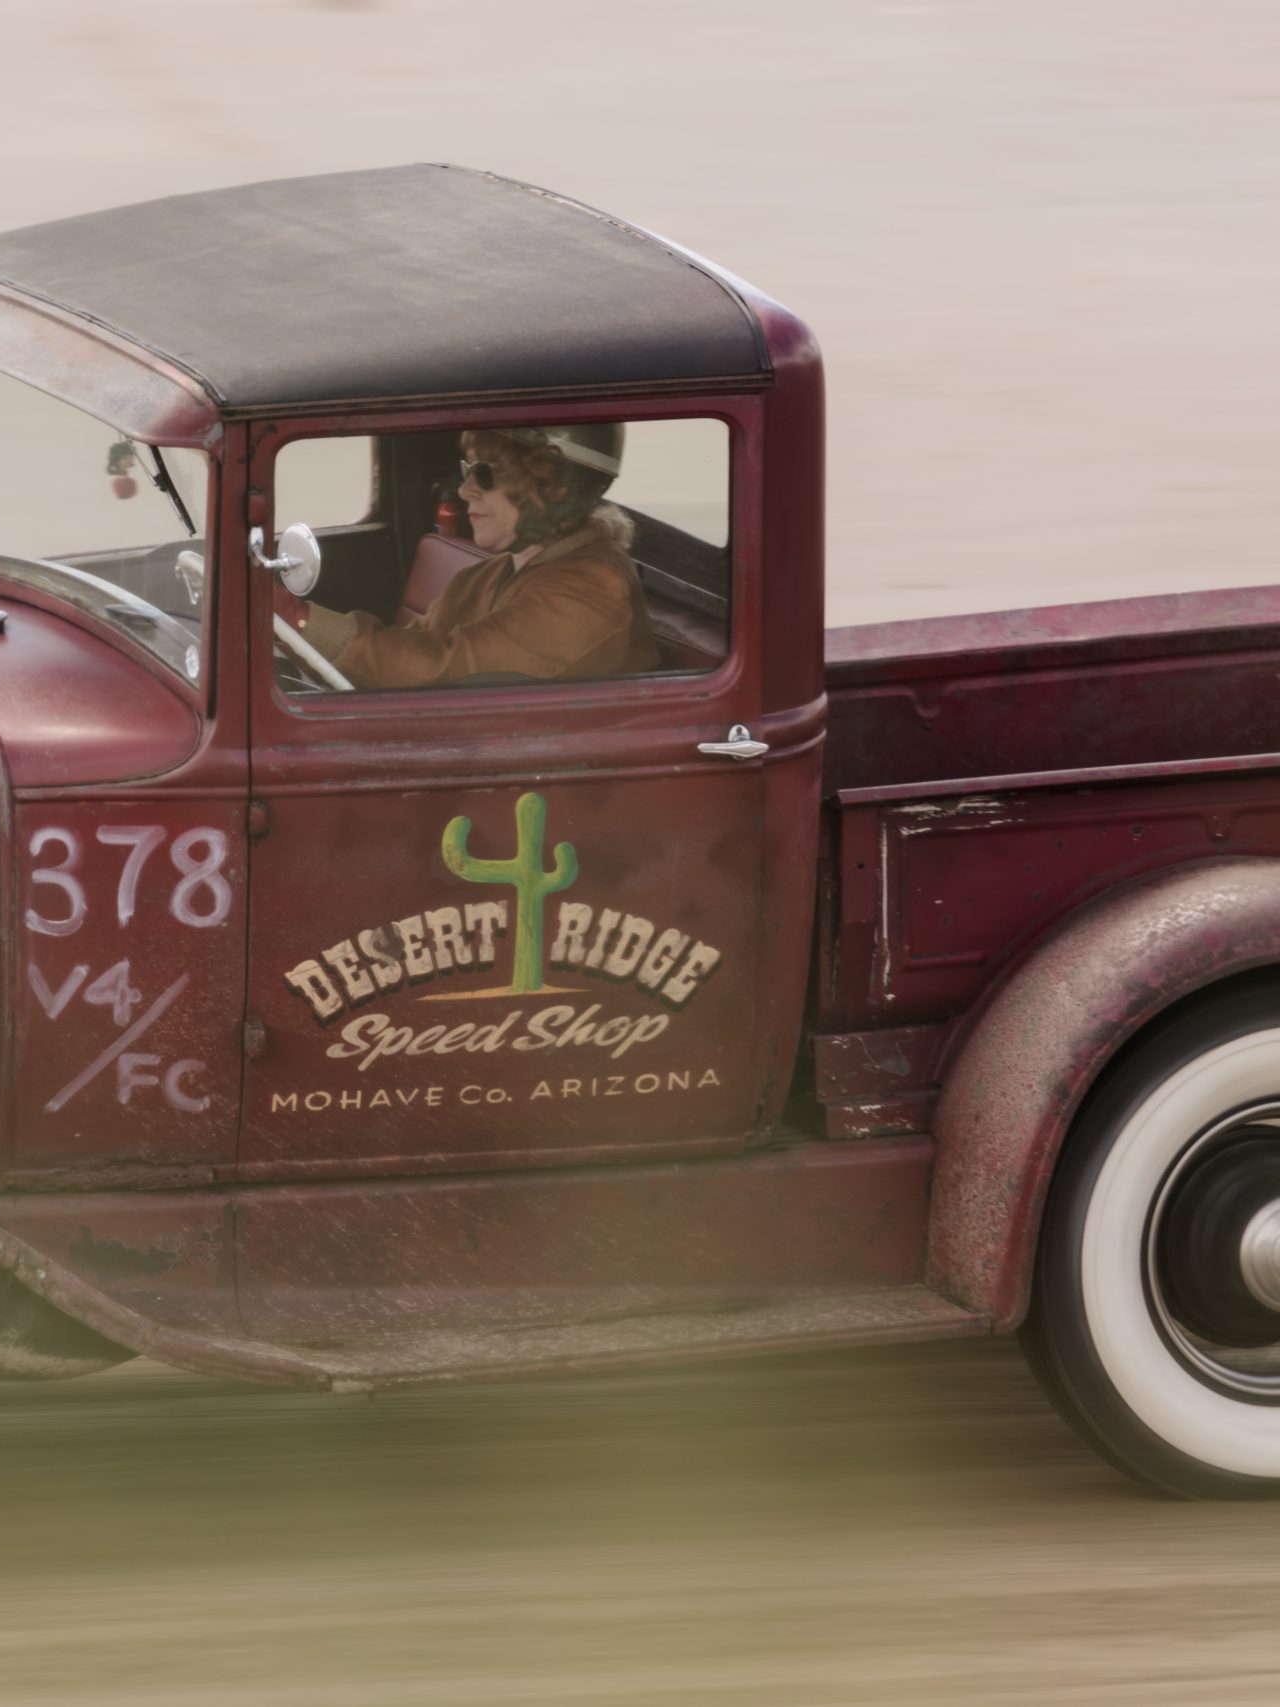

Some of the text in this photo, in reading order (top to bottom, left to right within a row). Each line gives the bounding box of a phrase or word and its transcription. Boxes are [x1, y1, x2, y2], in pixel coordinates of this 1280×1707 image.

[25, 824, 232, 937] 378
[284, 900, 721, 1022] DESERT RIDGE
[326, 1003, 670, 1072] Speed Shop
[271, 1086, 445, 1113] MOHAVE
[530, 1068, 721, 1101] ARIZONA
